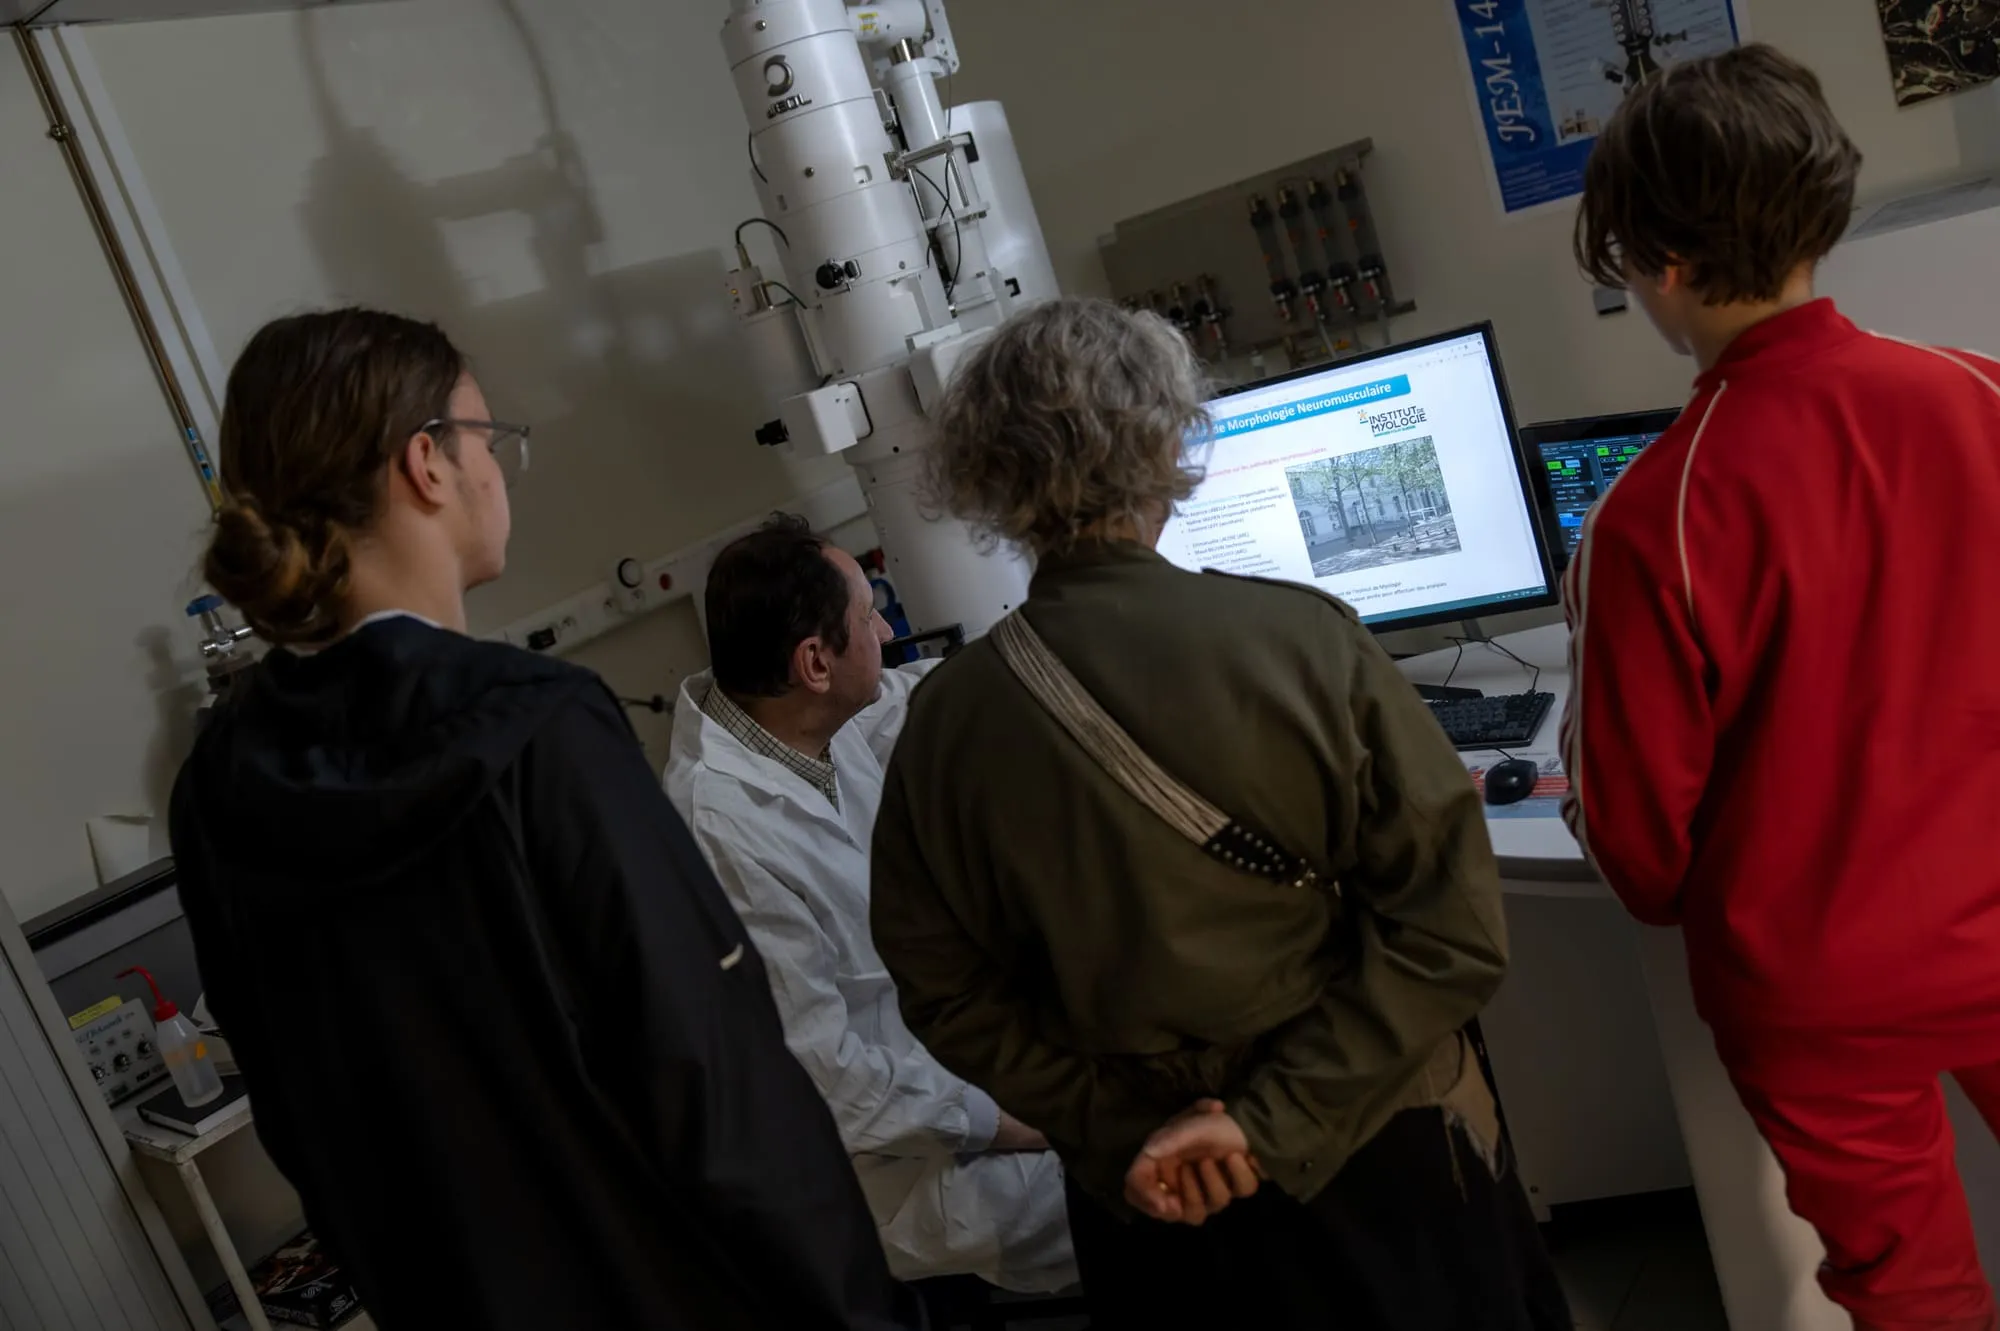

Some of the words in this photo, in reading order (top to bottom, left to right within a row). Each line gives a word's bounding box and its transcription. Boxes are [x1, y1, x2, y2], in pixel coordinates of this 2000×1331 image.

[1469, 0, 1536, 143] JEM-14
[767, 93, 812, 119] JEOL
[1214, 422, 1226, 434] de
[1227, 406, 1296, 432] Morphologie
[1297, 382, 1392, 414] Neuromusculaire
[1369, 406, 1416, 424] INSTITUT
[1371, 413, 1427, 433] MYOLOGIE
